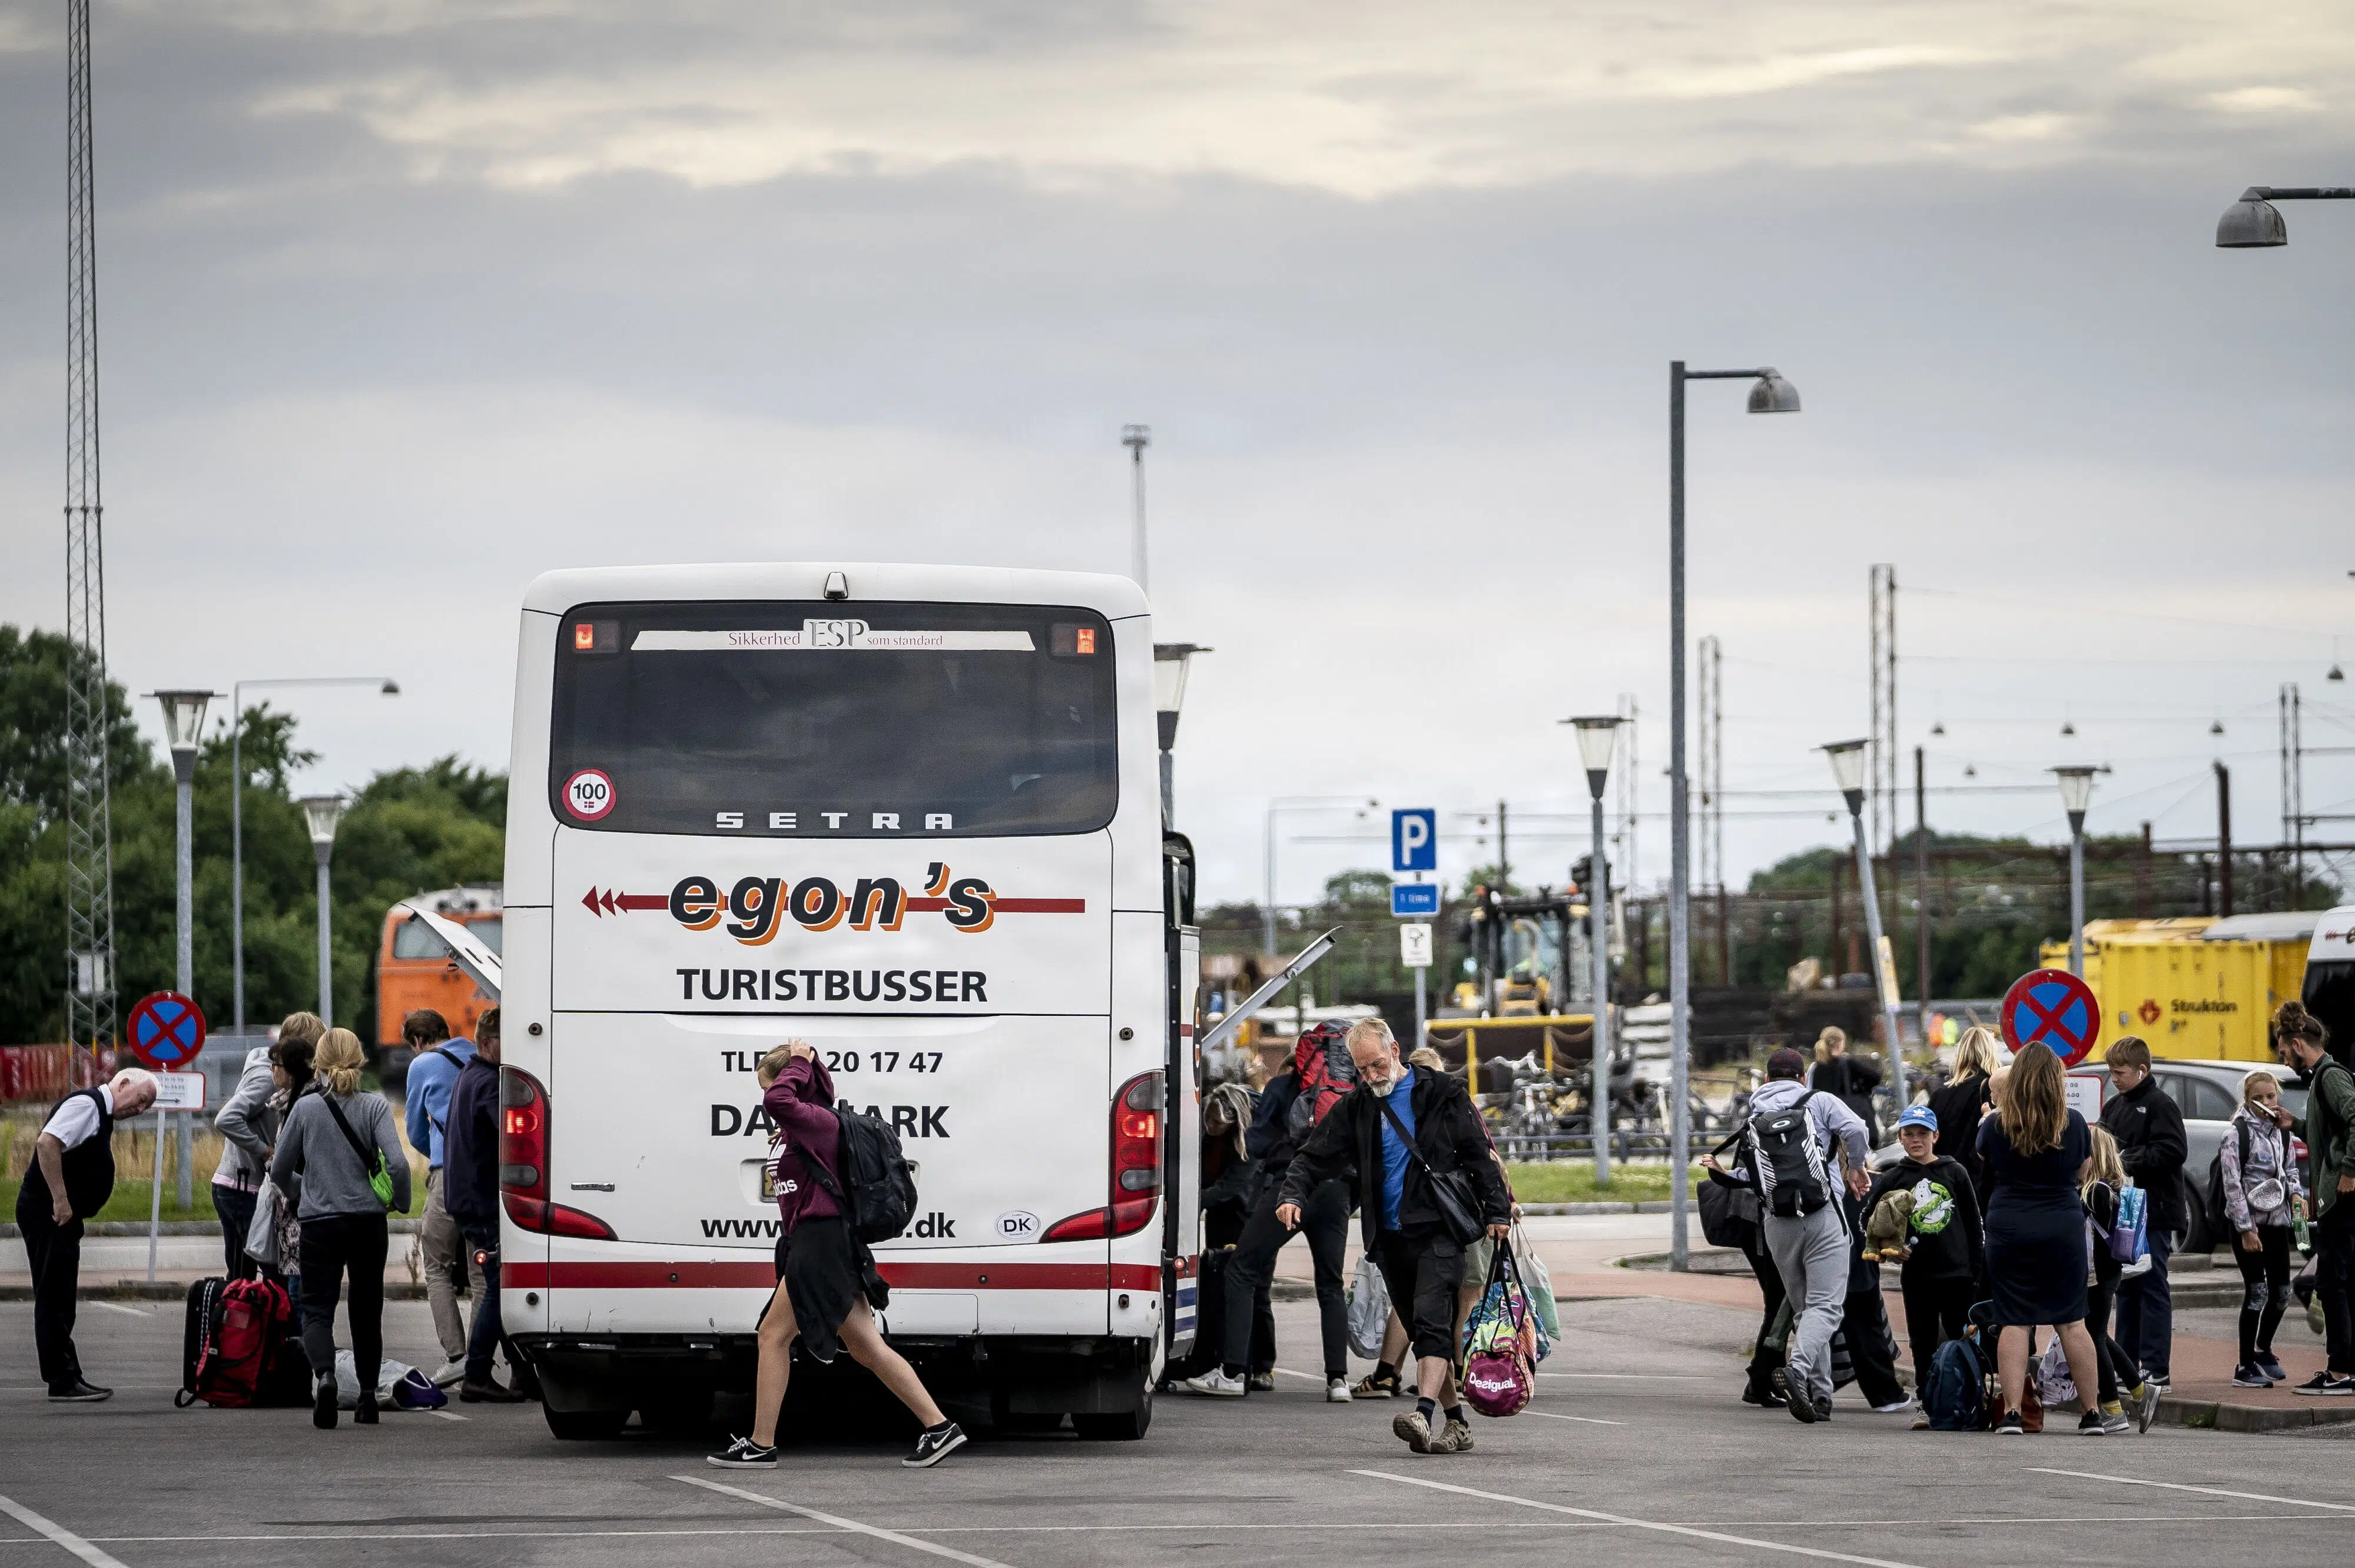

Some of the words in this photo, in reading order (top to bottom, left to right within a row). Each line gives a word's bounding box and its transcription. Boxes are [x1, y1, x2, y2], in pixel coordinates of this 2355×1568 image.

[728, 632, 801, 646] Sikkerhed
[809, 621, 865, 647] ESP
[867, 636, 890, 646] som
[893, 634, 943, 646] standard
[572, 781, 607, 800] 100
[717, 812, 953, 830] SETRA
[1401, 815, 1429, 866] P
[669, 862, 996, 946] egon's
[676, 969, 988, 1002] TURISTBUSSER
[827, 1051, 860, 1073] 20
[870, 1052, 900, 1073] 17
[909, 1052, 943, 1074] 47
[711, 1104, 951, 1138] DARK
[1004, 1218, 1032, 1233] DK
